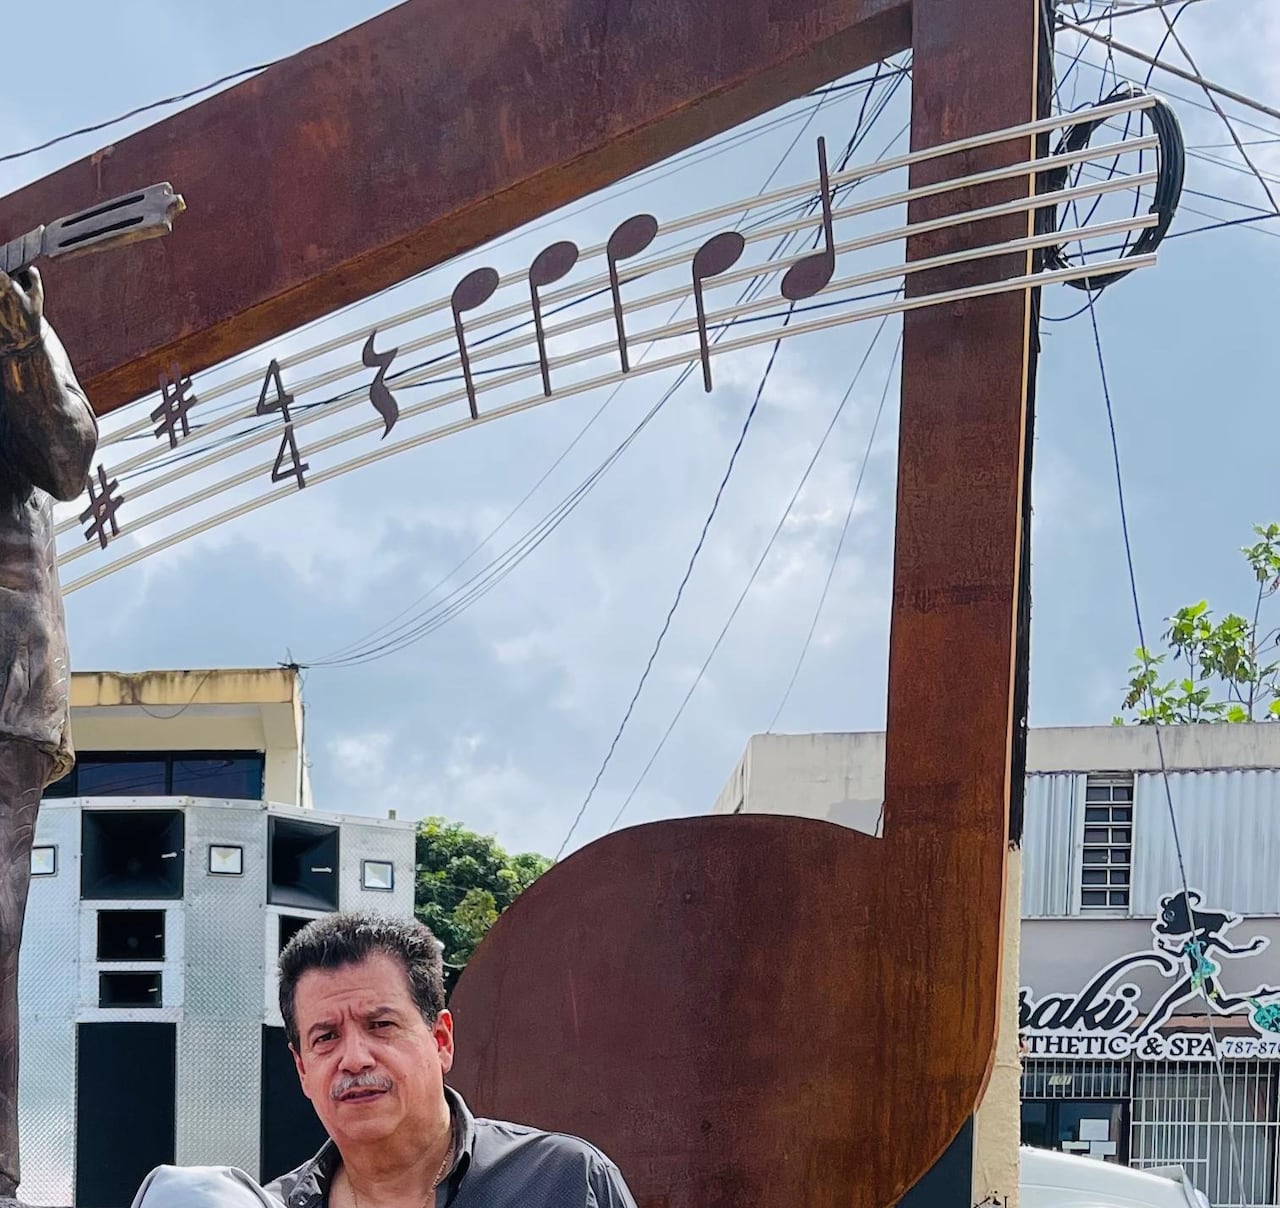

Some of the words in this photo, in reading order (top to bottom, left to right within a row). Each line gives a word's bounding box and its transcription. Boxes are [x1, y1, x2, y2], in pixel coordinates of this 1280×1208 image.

[1019, 1035, 1128, 1054] THETIC
[1142, 1037, 1163, 1055] &
[1169, 1037, 1216, 1056] SPA
[1225, 1041, 1280, 1055] 787-87
